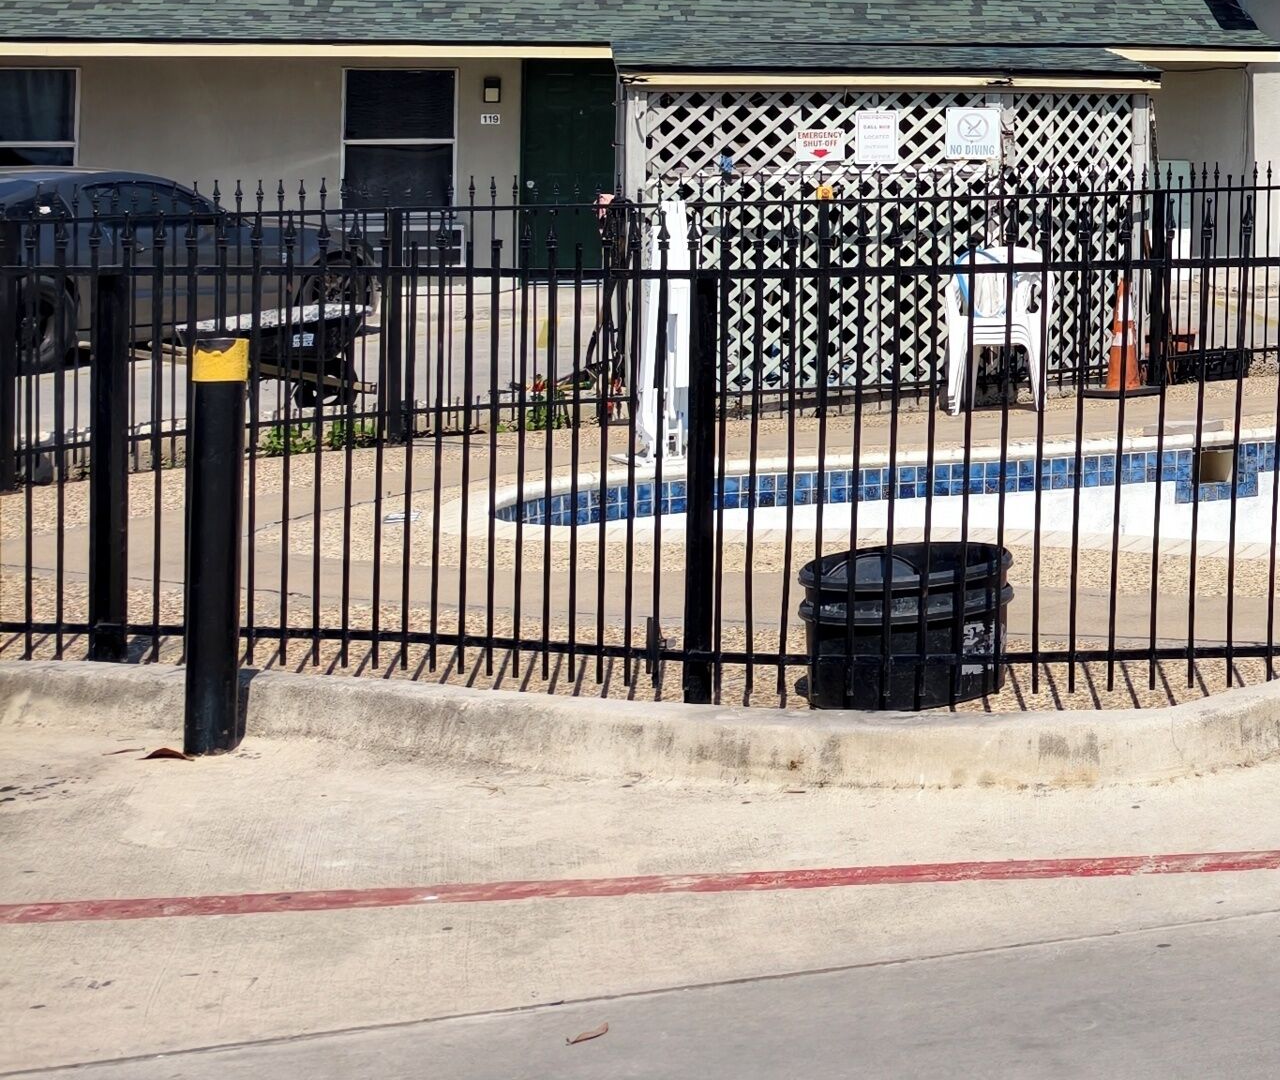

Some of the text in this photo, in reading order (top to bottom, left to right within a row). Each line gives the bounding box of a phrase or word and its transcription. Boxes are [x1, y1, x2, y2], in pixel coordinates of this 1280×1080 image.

[482, 115, 499, 123] 119
[797, 131, 843, 140] EMERGENCY
[803, 140, 837, 148] SHUT-OFF
[950, 144, 995, 156] NO DIVING
